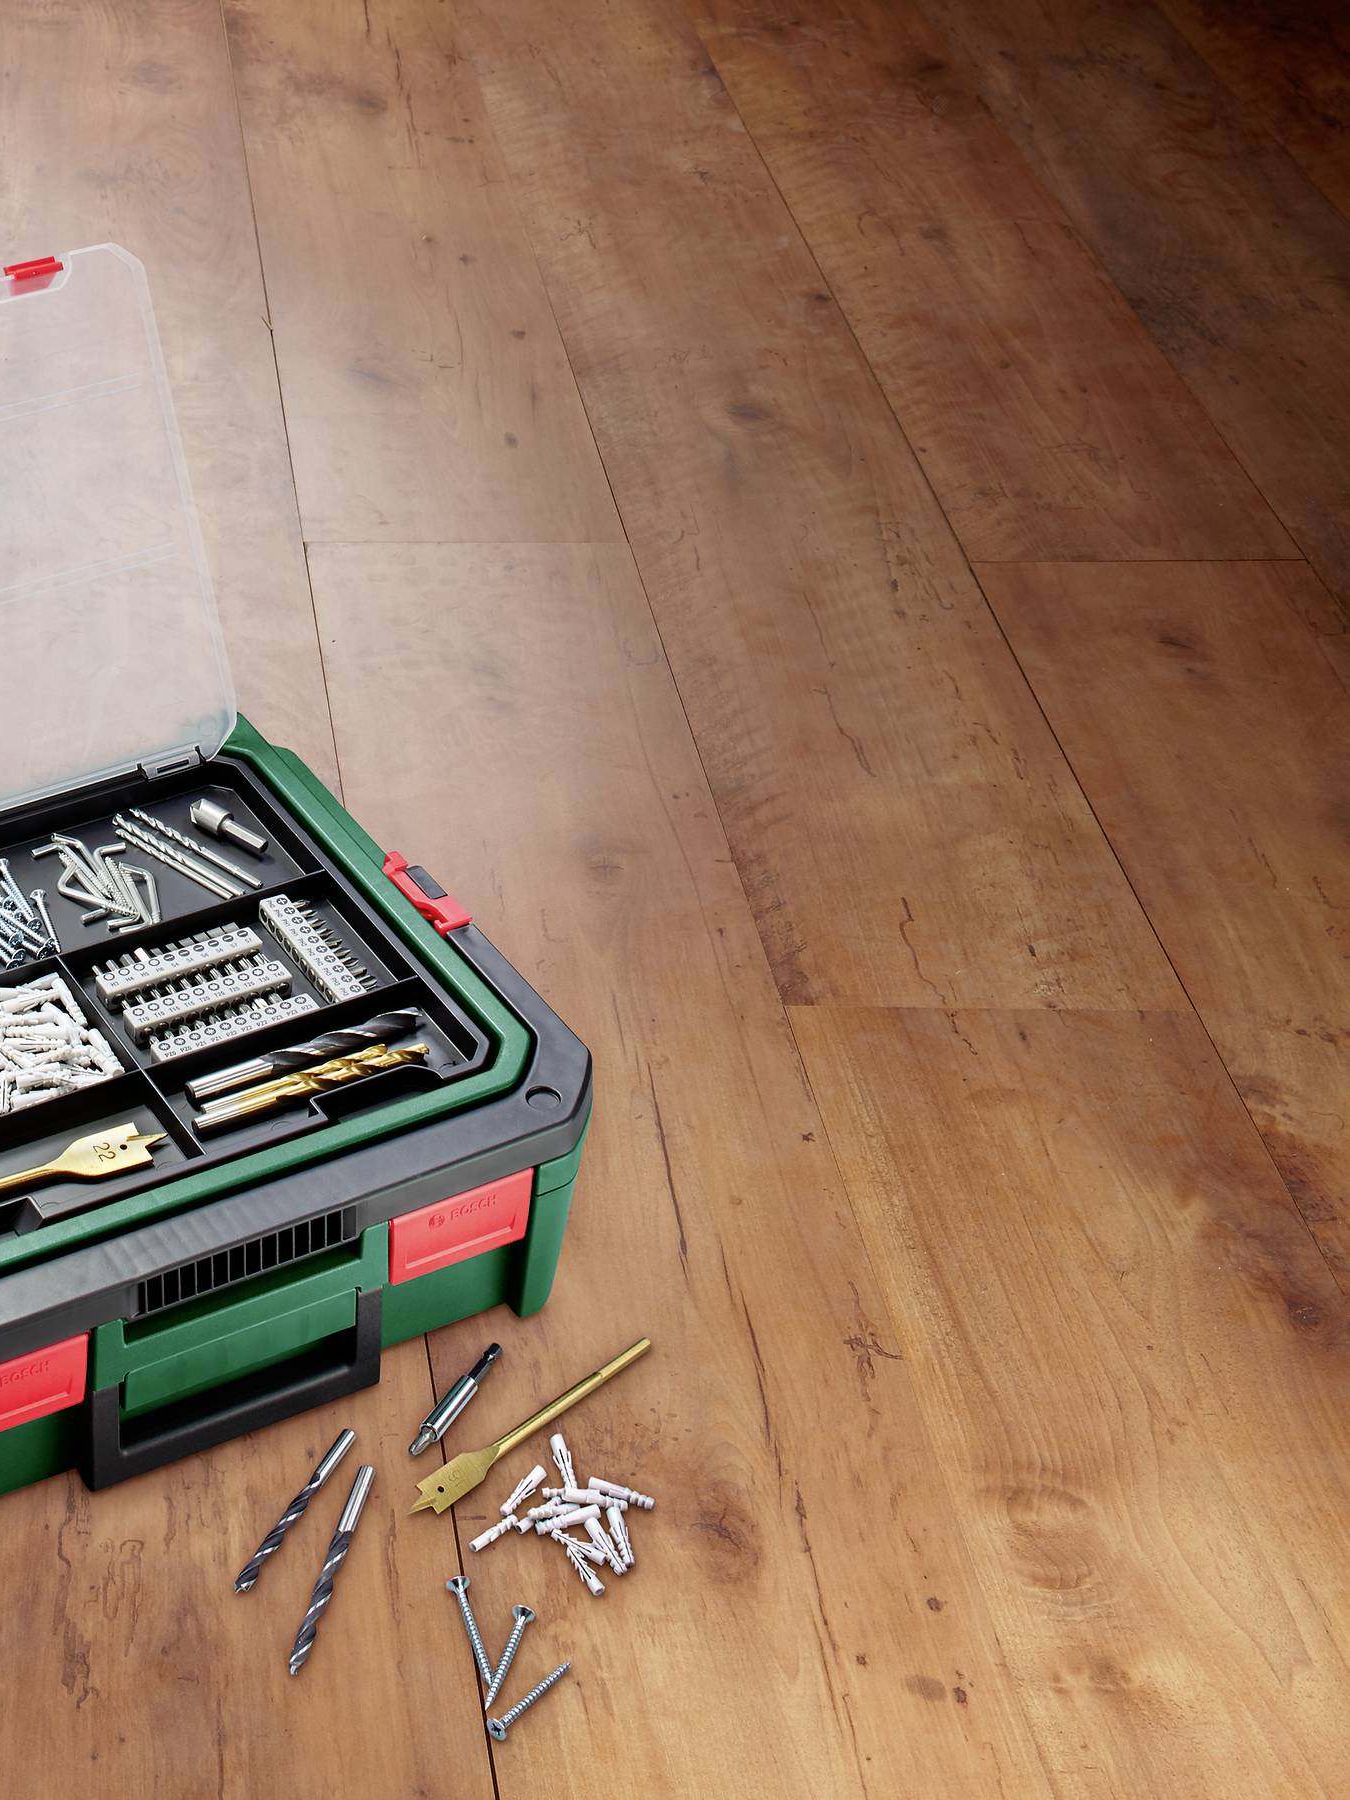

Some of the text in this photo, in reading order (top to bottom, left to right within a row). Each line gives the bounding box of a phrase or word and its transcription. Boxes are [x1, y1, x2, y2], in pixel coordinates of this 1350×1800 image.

[93, 1142, 116, 1162] 22
[449, 1193, 497, 1221] BOSCH
[0, 1360, 51, 1388] BOSCH
